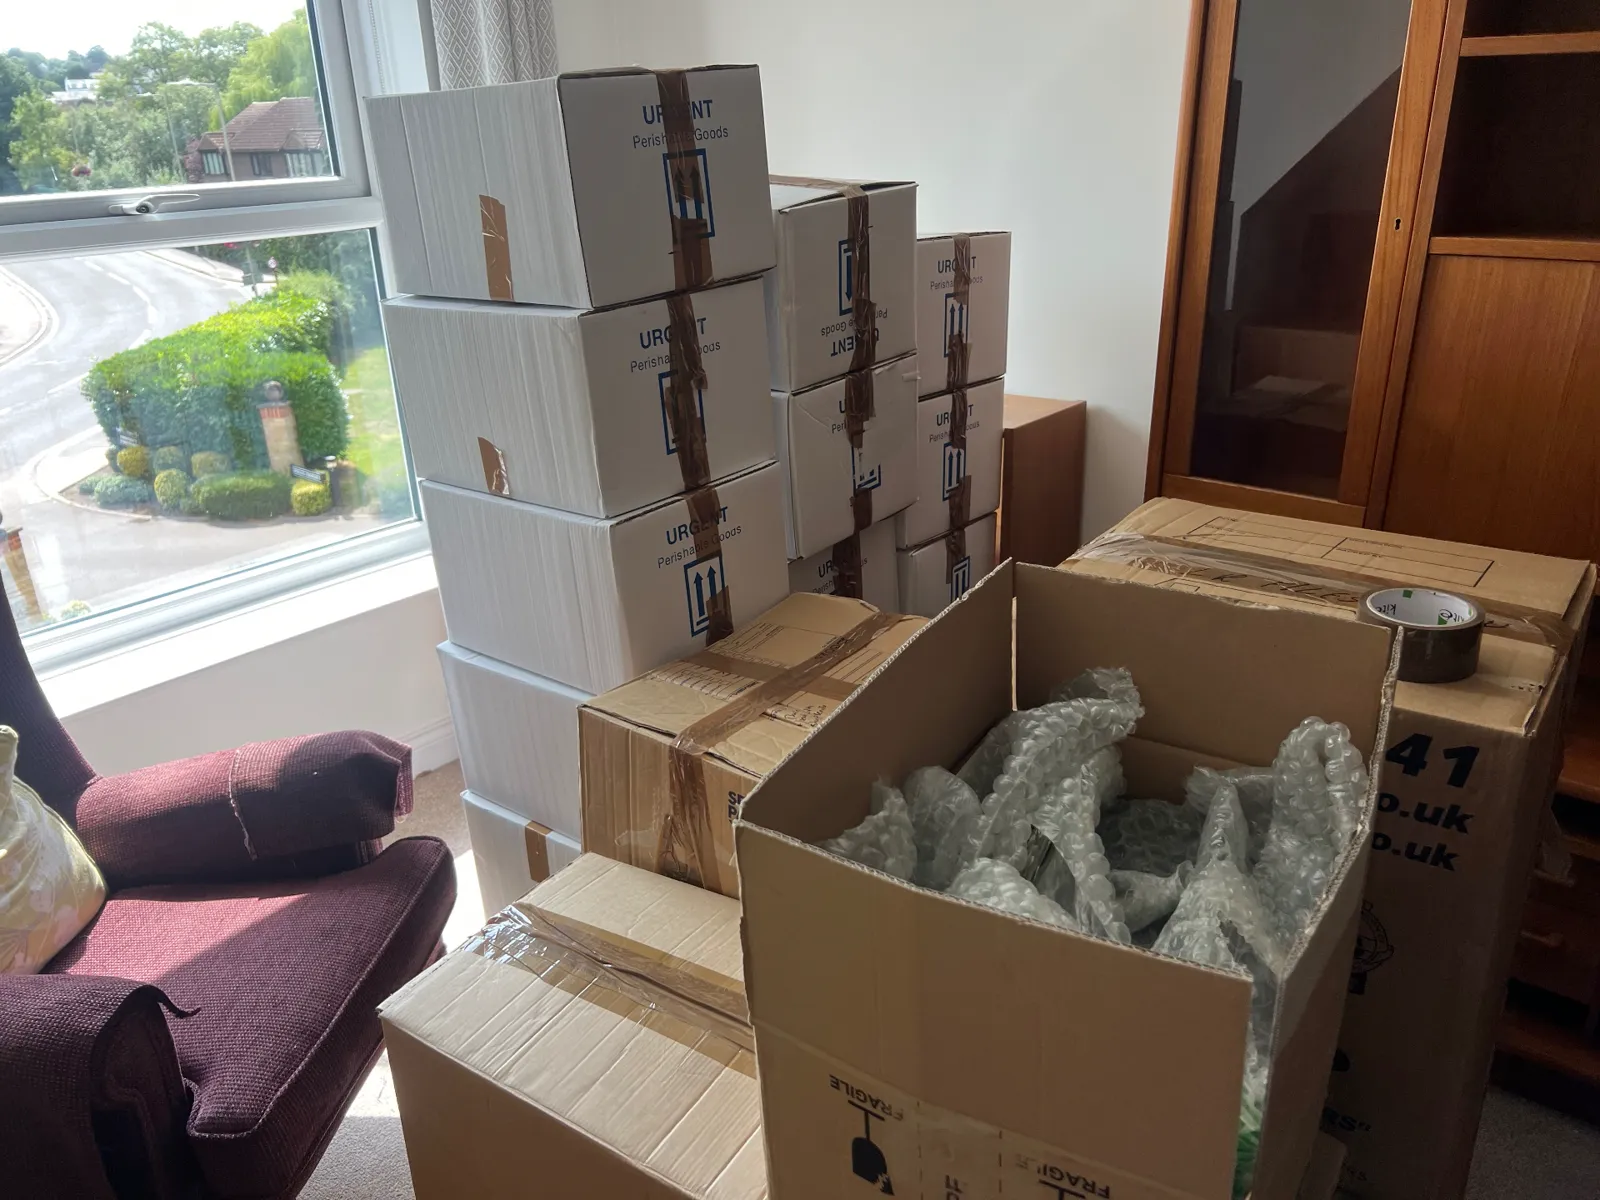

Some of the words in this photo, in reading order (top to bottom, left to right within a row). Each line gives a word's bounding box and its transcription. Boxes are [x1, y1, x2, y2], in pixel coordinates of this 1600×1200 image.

[695, 125, 729, 141] Goods
[820, 321, 847, 337] Goods
[712, 525, 742, 545] Goods
[829, 1073, 904, 1122] FRAGILE
